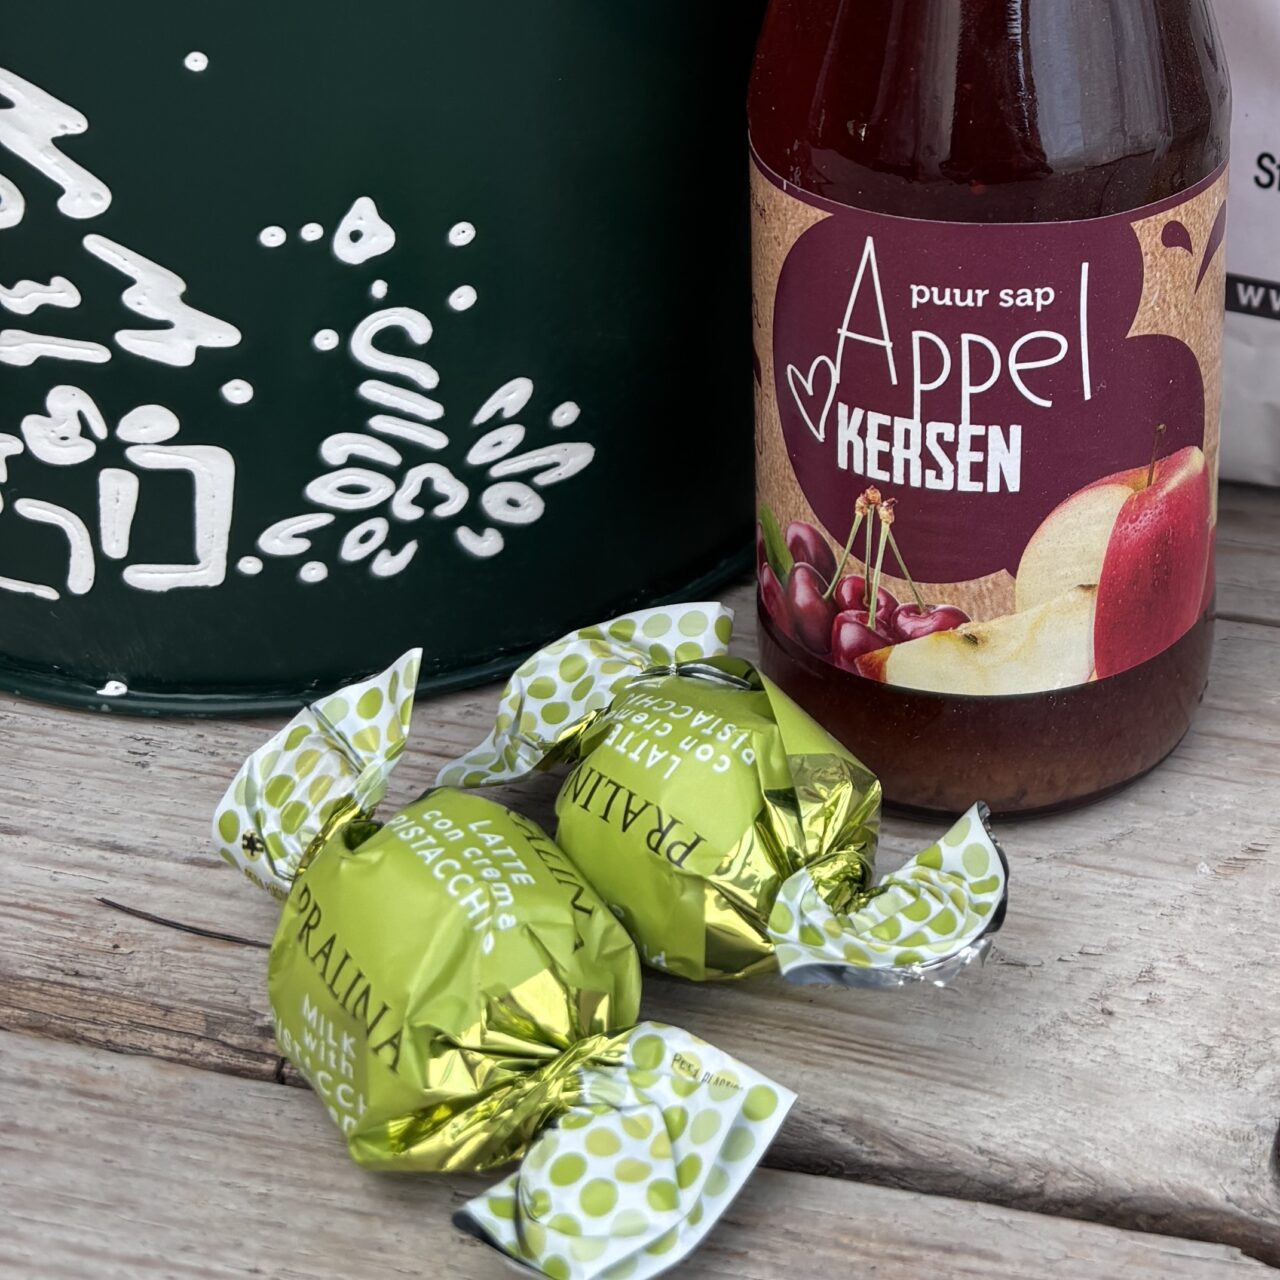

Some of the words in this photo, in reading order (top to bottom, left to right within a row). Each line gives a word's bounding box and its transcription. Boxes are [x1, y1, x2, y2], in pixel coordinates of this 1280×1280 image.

[836, 235, 1092, 420] Appel
[910, 283, 989, 308] puur
[998, 284, 1056, 312] sap
[837, 402, 1023, 493] KERSEN
[604, 722, 681, 780] LATTE
[679, 735, 731, 773] con
[422, 809, 465, 842] con
[468, 819, 536, 885] LATTE
[302, 992, 357, 1059] MILK
